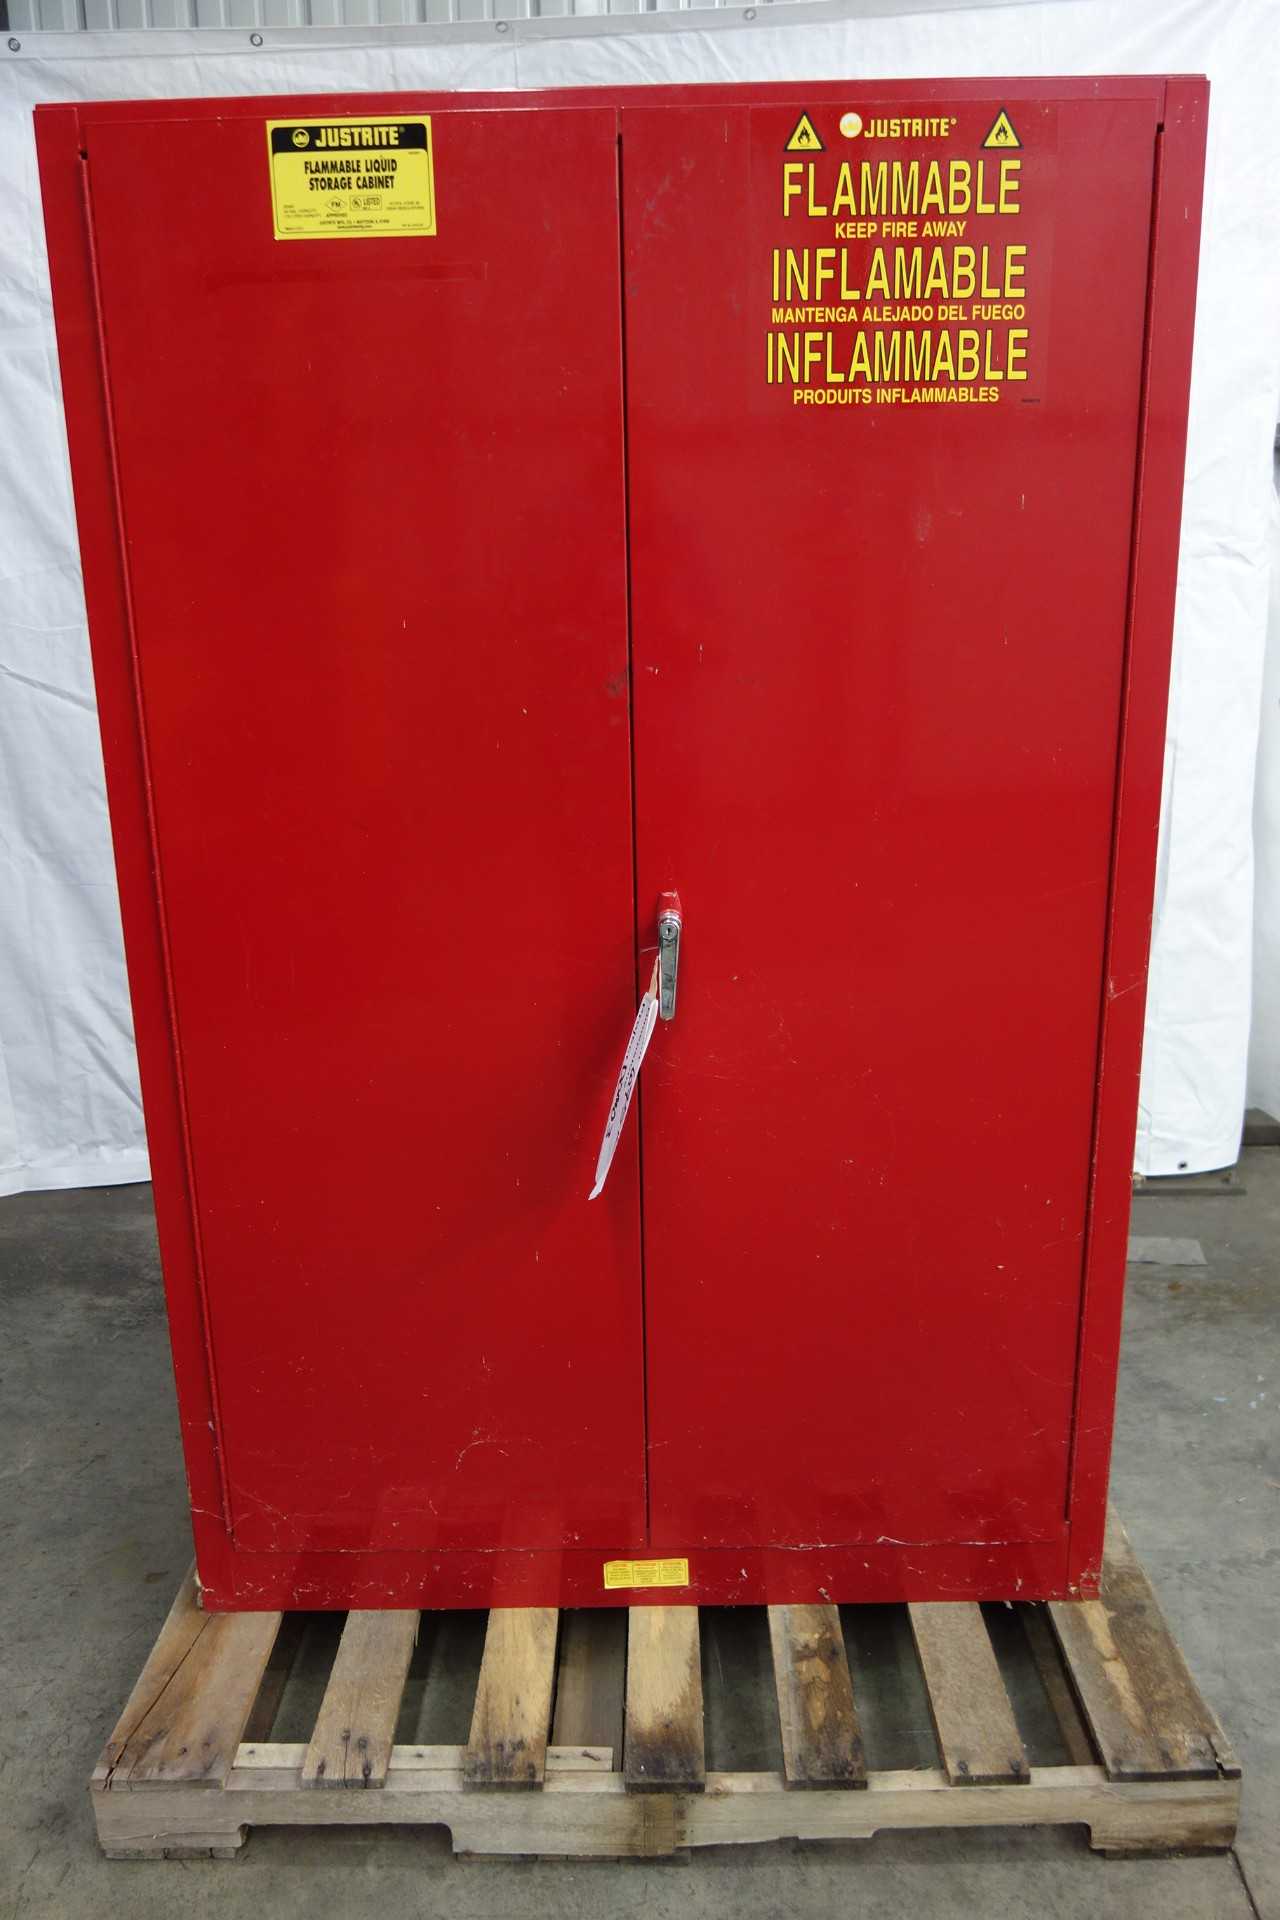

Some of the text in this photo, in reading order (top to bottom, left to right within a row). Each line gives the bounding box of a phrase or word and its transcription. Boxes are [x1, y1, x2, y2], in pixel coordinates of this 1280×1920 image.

[304, 158, 398, 174] FLAMMABLE LIQUID
[309, 175, 395, 191] STORAGE CABINET
[783, 159, 1021, 217] FLAMMABLE
[835, 221, 967, 239] KEEP FIRE AWAY
[772, 245, 1027, 301] INFLAMABLE
[771, 304, 1026, 323] MANTENGA ALEJADO DEL FUEGO
[766, 329, 1029, 384] INFLAMMABLE
[793, 387, 1000, 405] PRODUITS INFLAMMABLES
